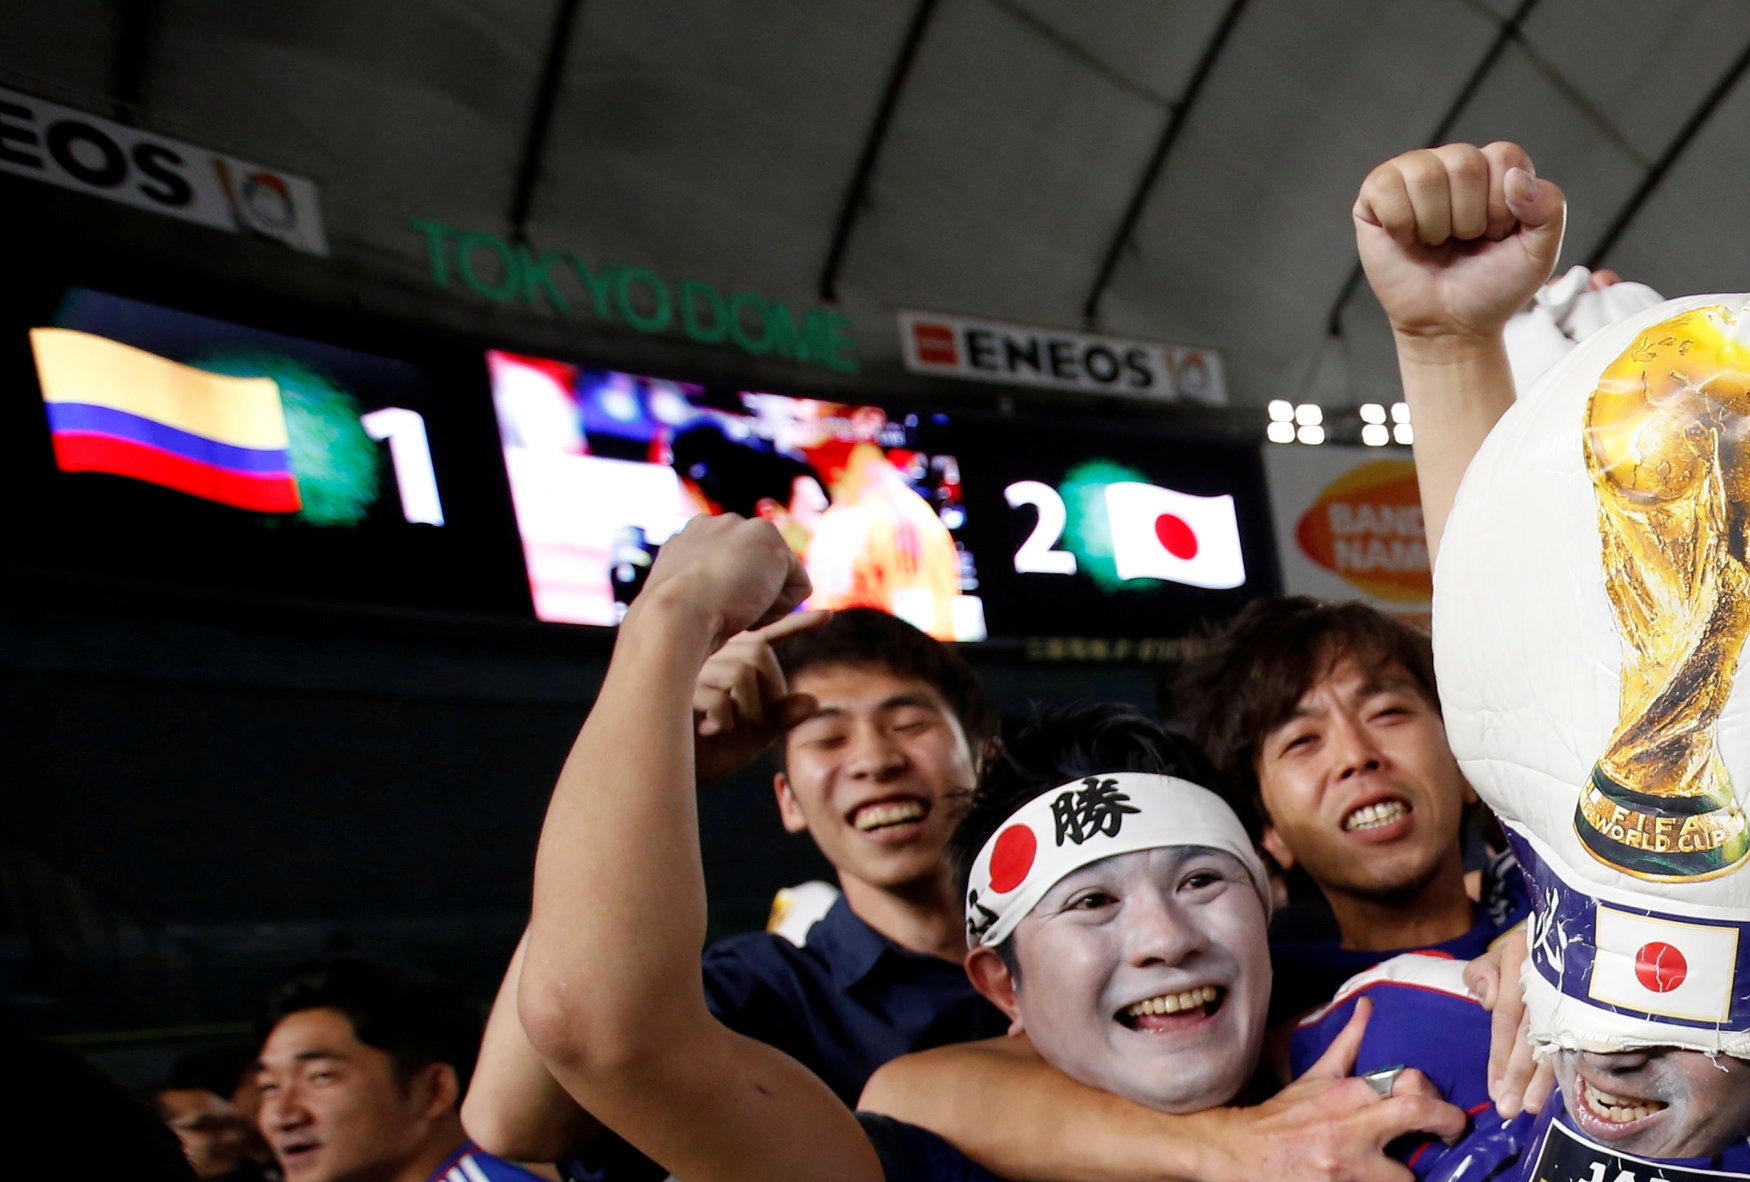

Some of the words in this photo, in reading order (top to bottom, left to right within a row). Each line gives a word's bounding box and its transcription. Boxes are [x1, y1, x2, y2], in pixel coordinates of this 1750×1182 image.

[408, 216, 672, 333] TOKYO
[679, 278, 861, 374] DOME
[963, 327, 1155, 389] ENEOS
[360, 406, 445, 527] 1
[1003, 479, 1078, 576] 2
[1050, 776, 1142, 847] 勝
[1594, 815, 1671, 852] WORLD
[1678, 829, 1727, 852] CUP
[1611, 808, 1705, 836] FIFA
